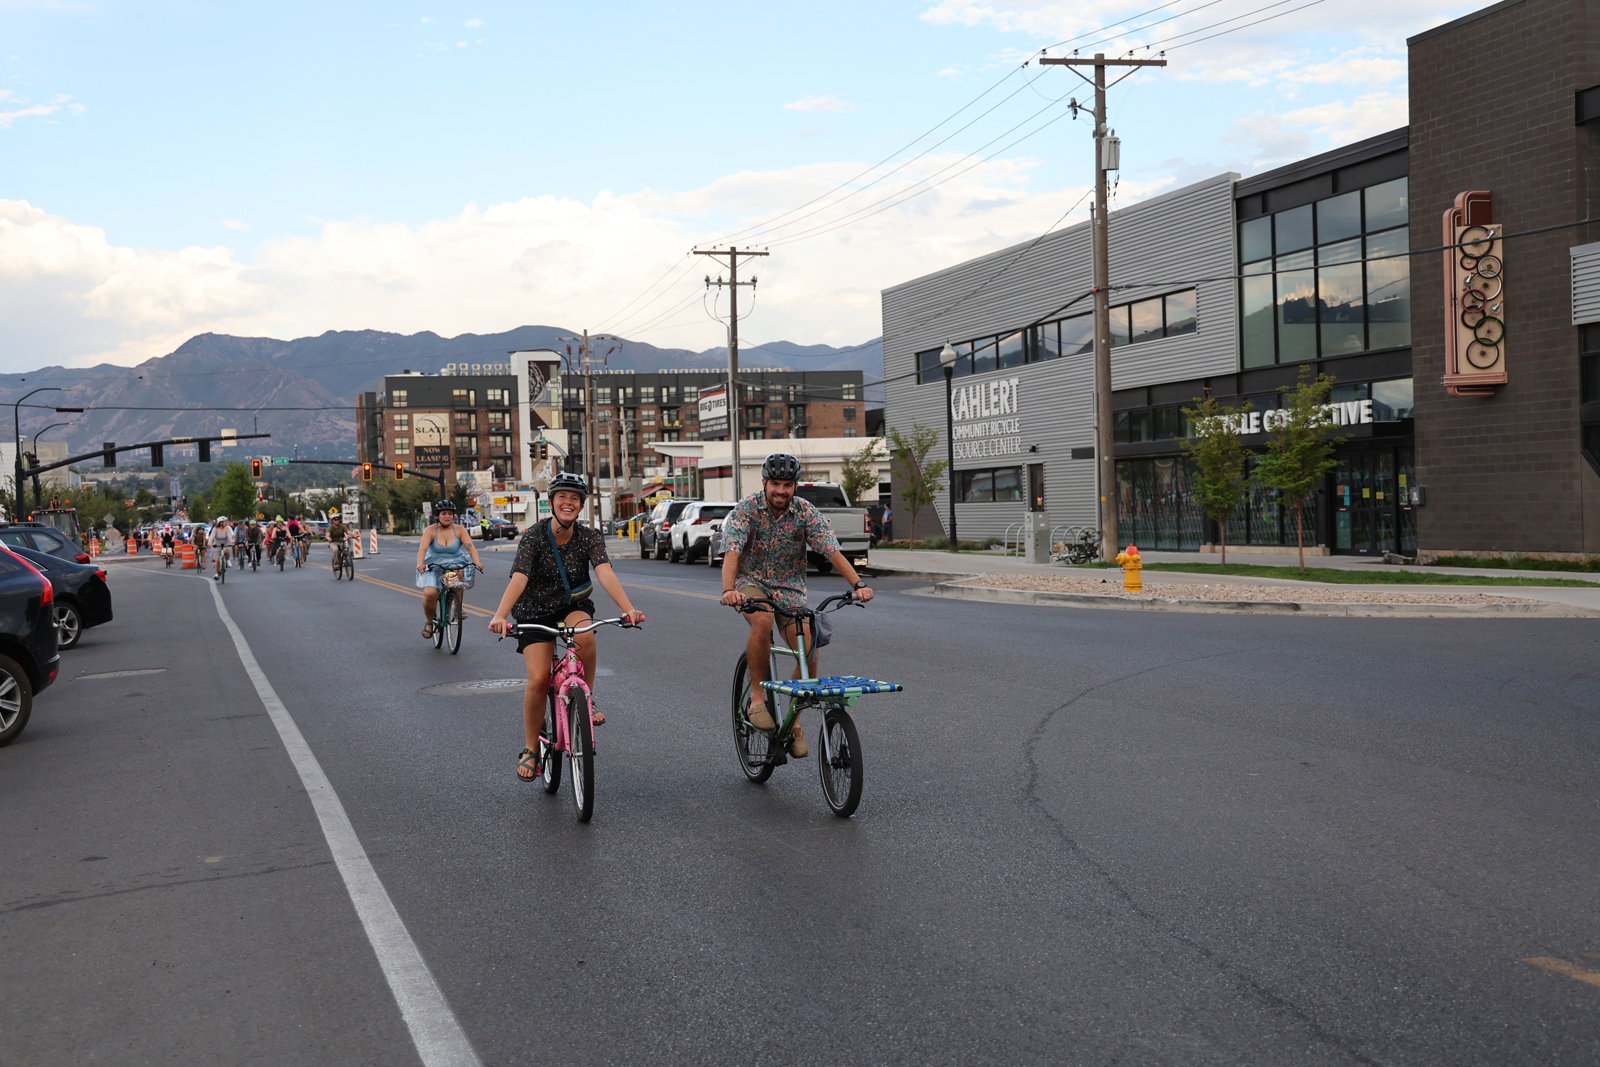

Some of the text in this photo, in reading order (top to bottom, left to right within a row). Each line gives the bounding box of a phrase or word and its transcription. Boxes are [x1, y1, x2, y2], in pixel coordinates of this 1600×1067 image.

[712, 398, 726, 408] TIRES
[951, 378, 1019, 421] KAHLERT
[1262, 400, 1372, 433] COCTIVE
[952, 418, 1020, 440] OMMUNITY BICYCLE
[953, 436, 1021, 460] ESOURCE CENTER
